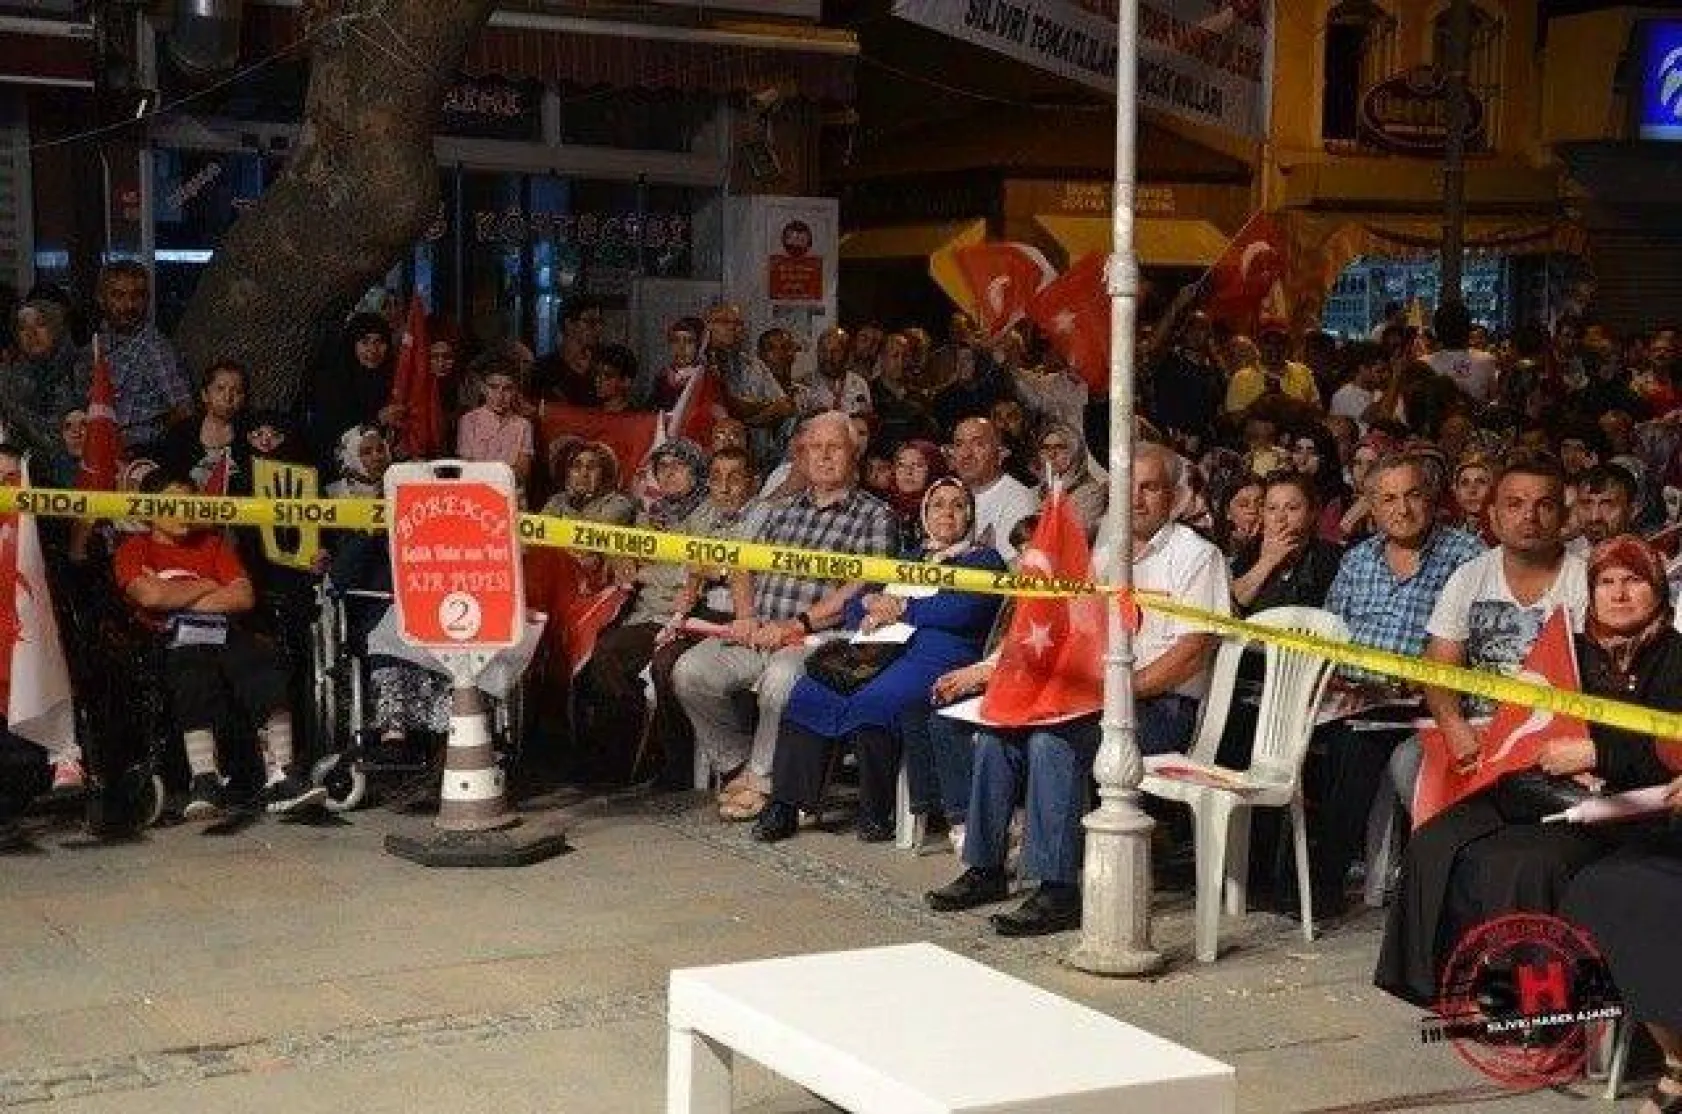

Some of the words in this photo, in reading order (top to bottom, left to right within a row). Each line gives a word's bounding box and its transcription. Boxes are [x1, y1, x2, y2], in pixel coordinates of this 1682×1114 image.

[16, 491, 87, 513] POLİS
[127, 497, 237, 521] GİRİLMEZ
[273, 503, 337, 524] POLİS
[572, 525, 657, 556] GİRİLMEZ
[686, 540, 740, 564] POLİS
[770, 551, 863, 580] GİRİLMEZ
[895, 564, 955, 586] POLİS
[449, 600, 468, 630] 2
